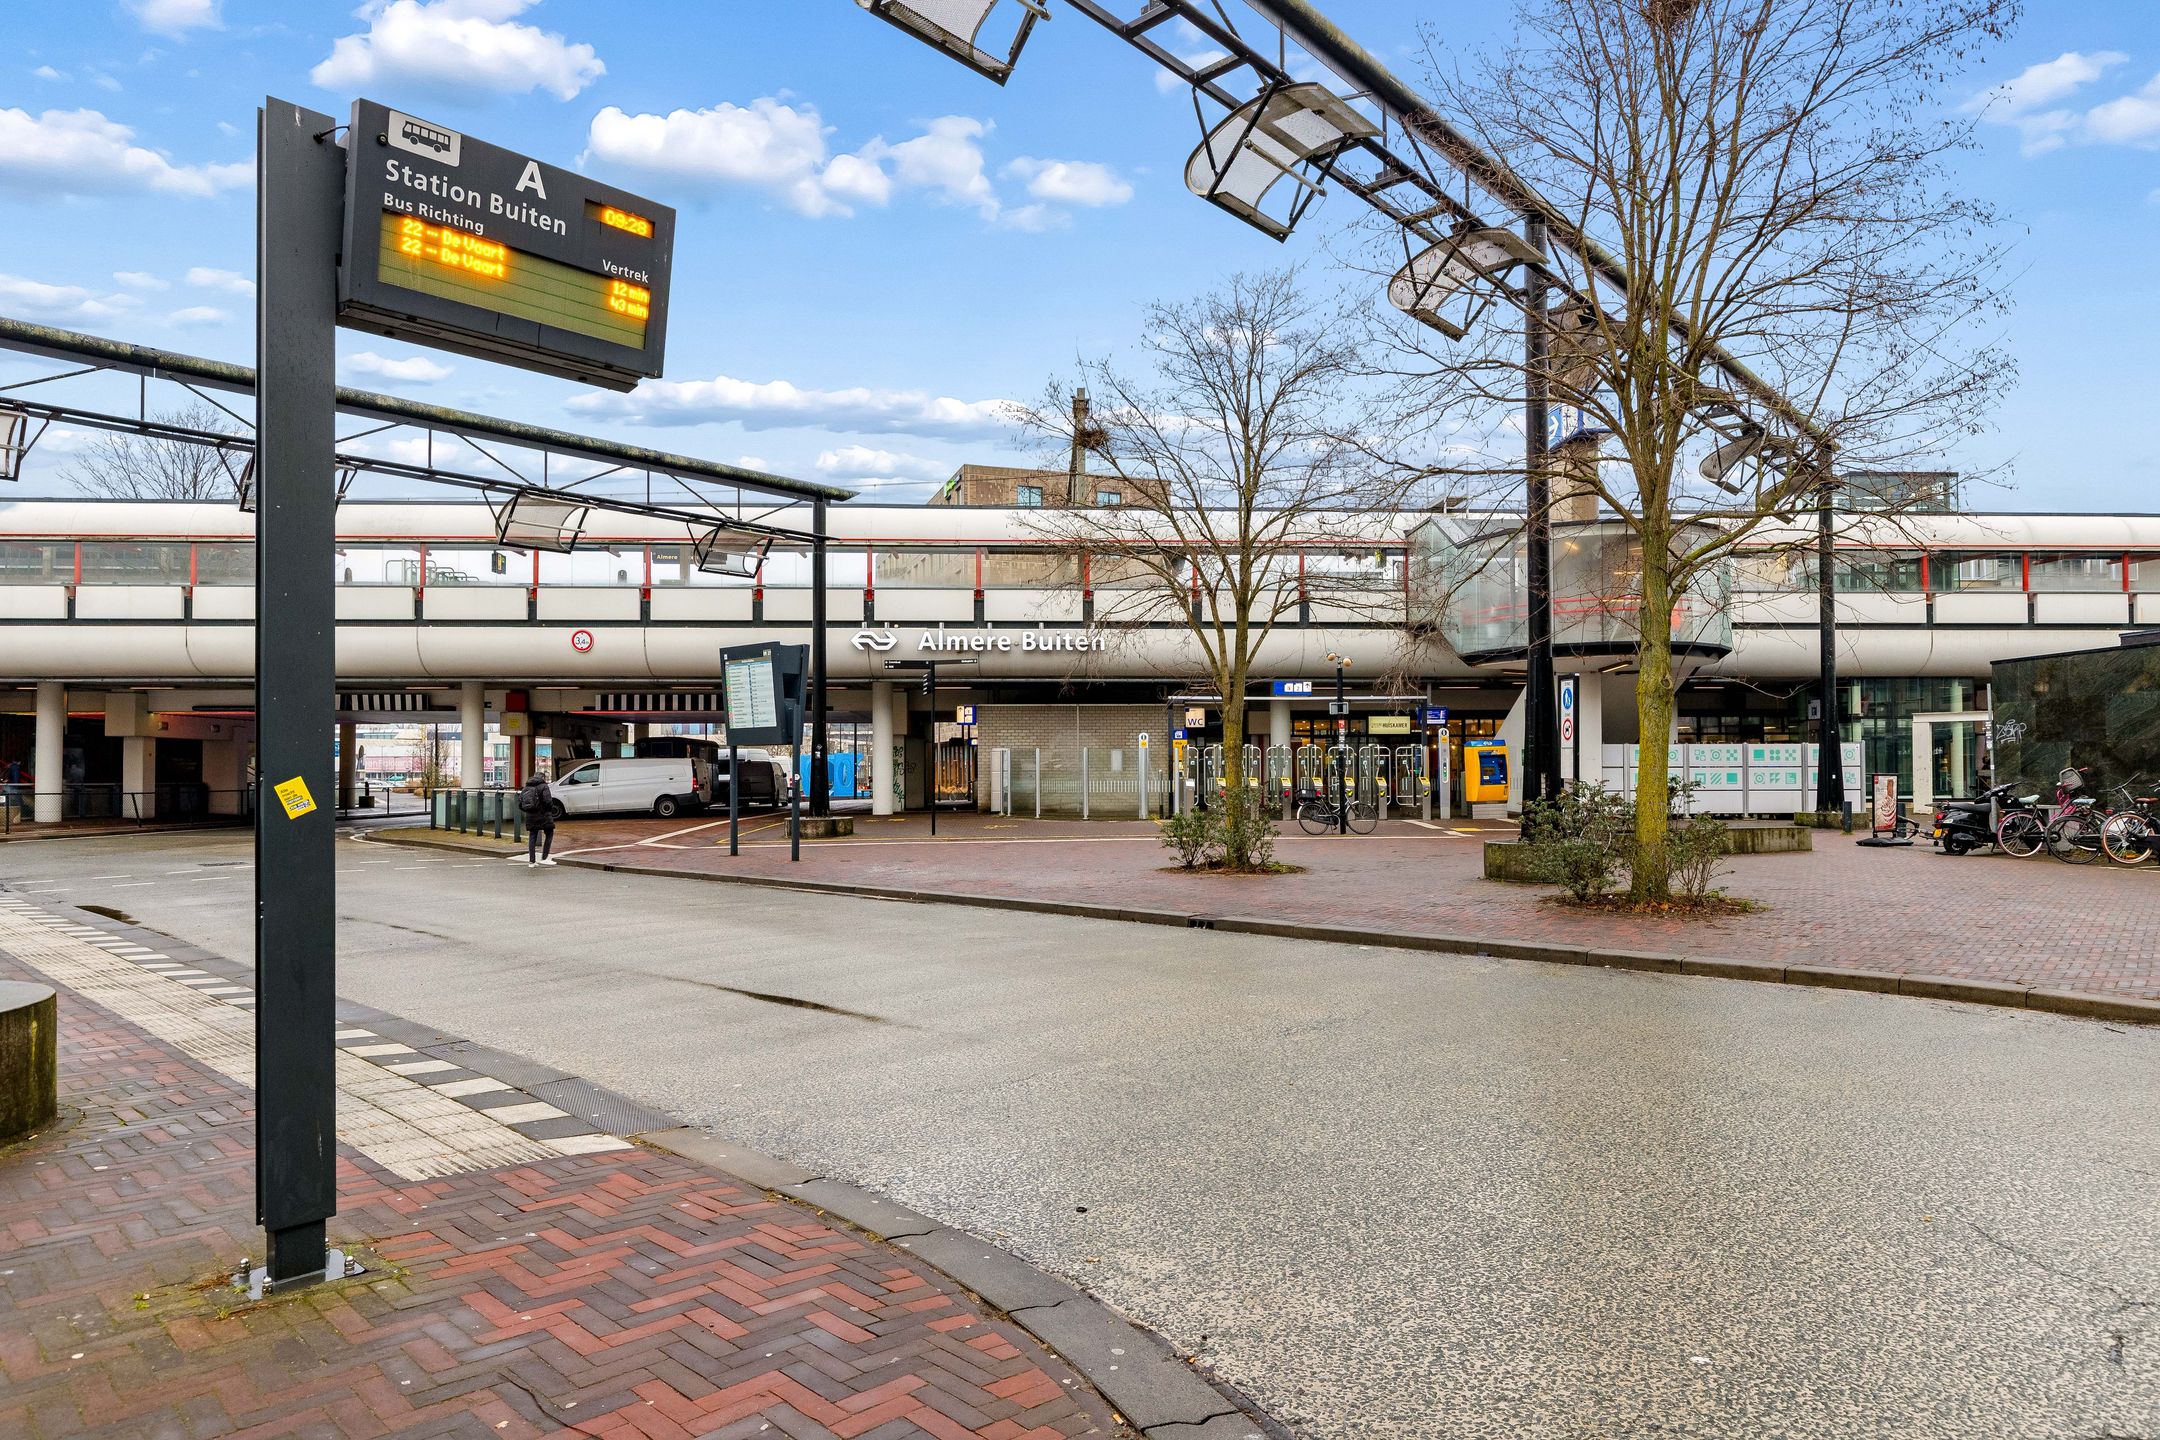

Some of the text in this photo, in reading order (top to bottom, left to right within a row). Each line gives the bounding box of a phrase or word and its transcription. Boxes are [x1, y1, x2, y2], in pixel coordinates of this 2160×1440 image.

[515, 160, 547, 200] A
[385, 159, 566, 236] Station Buiten
[383, 192, 484, 236] Bus Richting
[605, 209, 648, 235] 09:28
[402, 218, 423, 237] 22
[442, 230, 461, 248] De
[401, 236, 421, 255] 22
[441, 248, 460, 265] De
[602, 258, 649, 284] Vertrek
[612, 280, 648, 304] 12 min
[610, 296, 647, 320] 43 min
[917, 630, 1106, 651] Almere Buiten
[1188, 718, 1204, 726] WC
